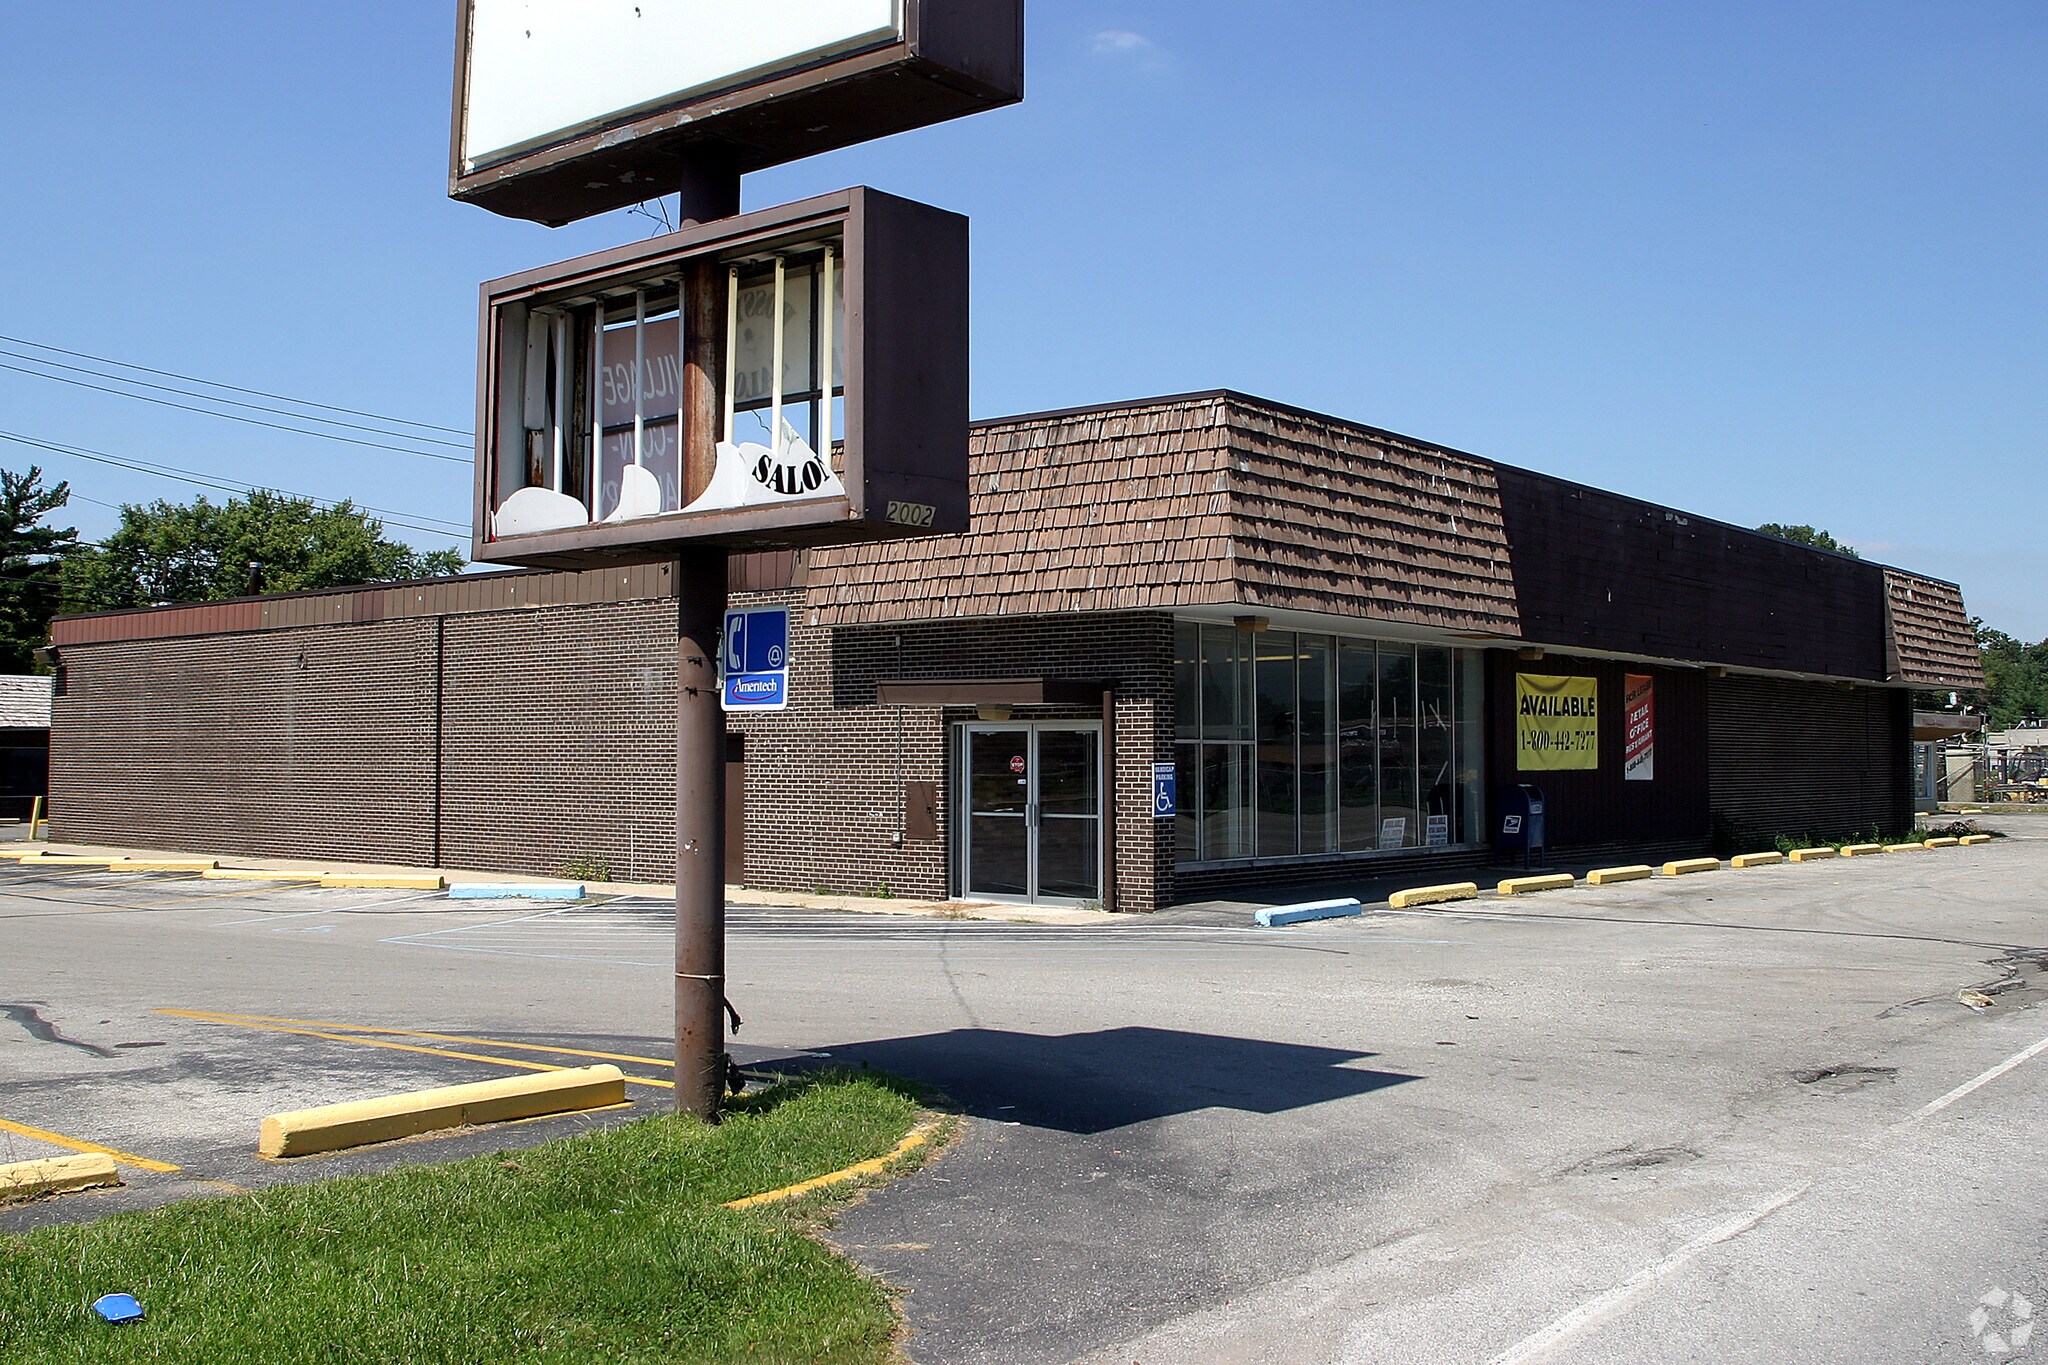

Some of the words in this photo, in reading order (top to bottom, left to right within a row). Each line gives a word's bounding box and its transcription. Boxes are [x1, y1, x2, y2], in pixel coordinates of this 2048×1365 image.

[886, 502, 932, 525] 2002
[734, 677, 777, 692] Ameritech
[1520, 694, 1595, 717] AVAILABLE
[1629, 717, 1649, 739] OFFICE
[1521, 729, 1595, 751] 1-800-442-7277
